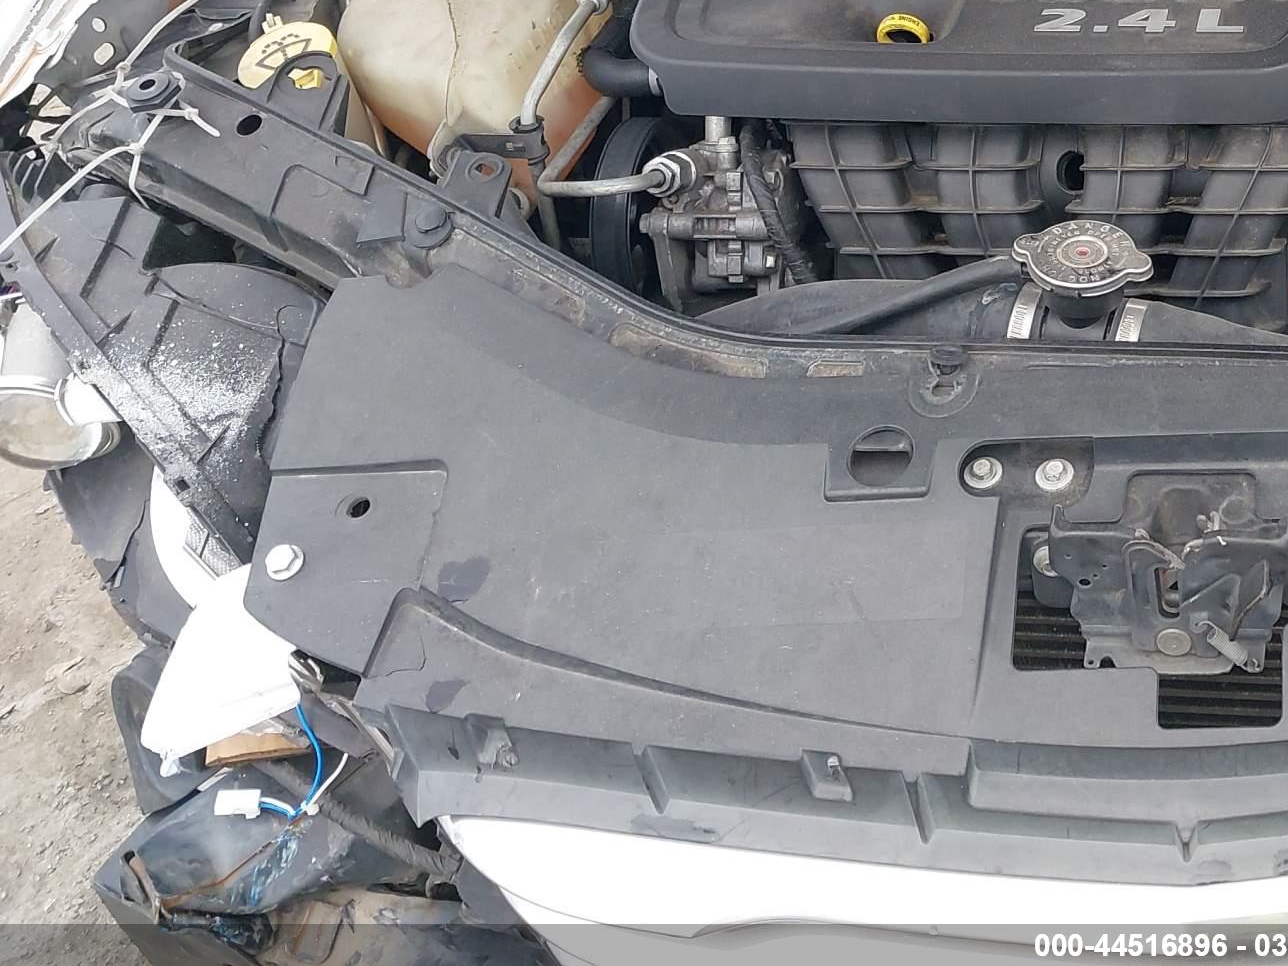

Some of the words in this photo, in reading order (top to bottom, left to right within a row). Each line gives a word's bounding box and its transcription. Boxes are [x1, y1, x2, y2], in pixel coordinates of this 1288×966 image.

[1033, 8, 1177, 34] 2.4
[1196, 8, 1245, 34] L
[1052, 222, 1129, 246] DANGER
